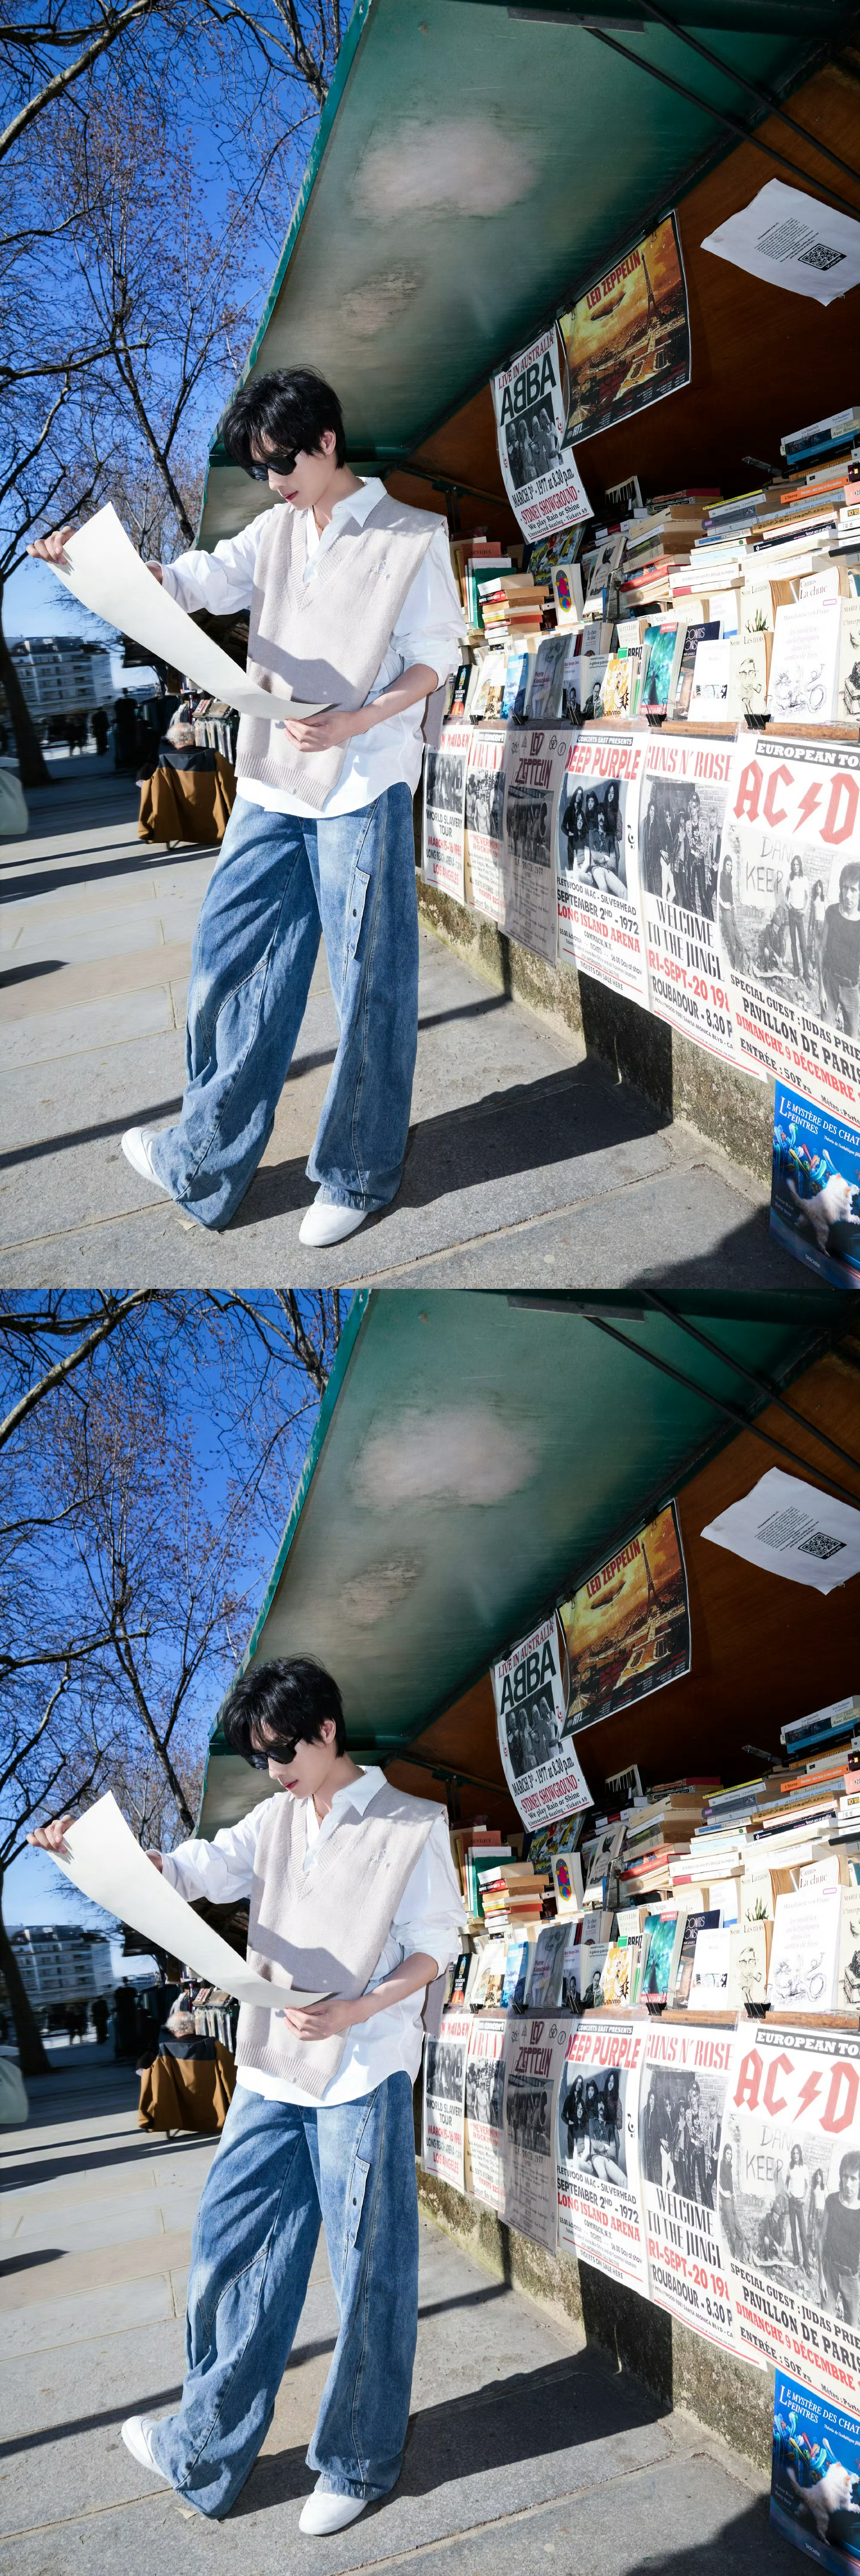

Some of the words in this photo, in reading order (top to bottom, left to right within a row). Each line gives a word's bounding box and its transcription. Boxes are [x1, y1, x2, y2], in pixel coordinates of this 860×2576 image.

[586, 288, 601, 310] LED
[601, 250, 641, 294] ZEPPELIN
[498, 368, 512, 390] LIVE
[513, 364, 520, 376] IN
[520, 333, 554, 371] AUSTRALIA
[500, 351, 556, 426] ABBA
[572, 423, 584, 437] RTL
[512, 488, 529, 508] MARCH
[536, 478, 548, 495] 1977
[548, 477, 553, 490] at
[552, 469, 563, 487] 8.30
[563, 468, 574, 486] p.m.
[521, 504, 541, 524] SYDNEY
[539, 486, 578, 516] SHOWGROUND
[538, 520, 546, 528] play
[546, 513, 559, 522] Rain
[565, 504, 580, 514] Shine
[528, 526, 549, 537] Unreserved
[550, 520, 564, 529] Seating
[566, 511, 581, 521] Tickets
[800, 580, 816, 588] Camus
[800, 589, 808, 599] La
[810, 584, 827, 597] chute
[592, 746, 642, 780] PURPLE
[756, 743, 836, 764] EUROPEAN
[426, 809, 442, 823] WORLD
[444, 815, 462, 829] SLAVERY
[439, 825, 452, 837] TOUR
[428, 836, 443, 849] MARCH
[433, 863, 442, 875] LOS
[442, 869, 459, 885] ANGELES
[534, 866, 543, 875] 1977
[557, 889, 598, 918] SEPTEMBER
[620, 915, 639, 935] 1972
[584, 888, 596, 900] MAC
[601, 894, 636, 916] SILVERHEAD
[558, 903, 579, 923] LONG
[580, 914, 608, 938] ISLAND
[611, 927, 641, 953] ARENA
[656, 899, 714, 948] WELCOME
[647, 921, 661, 946] TO
[662, 928, 683, 961] THE
[654, 997, 675, 1013] HOLLYWOOD
[683, 1015, 695, 1026] SANTA
[696, 1024, 711, 1037] MONICA
[712, 1034, 723, 1044] BLVD
[706, 1008, 725, 1035] 8.30
[731, 974, 765, 1003] SPECIAL
[766, 996, 795, 1021] GUEST
[802, 1016, 832, 1043] JUDAS
[742, 997, 799, 1046] PAVILLON
[801, 1034, 819, 1059] DE
[735, 1013, 784, 1056] DIMANCHE
[785, 1046, 791, 1060] 9
[792, 1050, 856, 1102] DÉCEMBRE
[740, 1037, 777, 1071] ENTRÉE
[787, 1111, 819, 1135] PEINTRES
[792, 1103, 822, 1126] MYSTÈRE
[823, 1120, 837, 1135] DES
[805, 1254, 820, 1268] TASCHEN
[586, 1577, 601, 1599] LED
[601, 1539, 641, 1583] ZEPPELIN
[498, 1657, 512, 1679] LIVE
[513, 1653, 520, 1665] IN
[520, 1622, 554, 1660] AUSTRALIA
[500, 1640, 556, 1715] ABBA
[572, 1712, 584, 1725] RTL
[512, 1777, 529, 1796] MARCH
[536, 1767, 548, 1784] 1977
[548, 1766, 553, 1778] at
[552, 1758, 563, 1776] 8.30
[563, 1757, 574, 1775] p.m.
[521, 1793, 541, 1813] SYDNEY
[539, 1774, 578, 1805] SHOWGROUND
[538, 1808, 546, 1817] play
[546, 1802, 559, 1811] Rain
[565, 1793, 580, 1803] Shine
[528, 1814, 549, 1826] Unreserved
[550, 1808, 564, 1817] Seating
[566, 1800, 581, 1810] Tickets
[800, 1869, 816, 1877] Camus
[800, 1878, 808, 1888] La
[810, 1873, 827, 1885] chute
[592, 2035, 642, 2069] PURPLE
[756, 2031, 836, 2053] EUROPEAN
[426, 2098, 442, 2112] WORLD
[444, 2104, 462, 2118] SLAVERY
[439, 2114, 452, 2126] TOUR
[428, 2125, 443, 2138] MARCH
[433, 2152, 442, 2164] LOS
[442, 2157, 459, 2174] ANGELES
[534, 2155, 543, 2164] 1977
[557, 2178, 598, 2206] SEPTEMBER
[620, 2204, 639, 2224] 1972
[584, 2177, 596, 2189] MAC
[601, 2183, 636, 2205] SILVERHEAD
[558, 2192, 579, 2212] LONG
[580, 2203, 608, 2227] ISLAND
[611, 2215, 641, 2242] ARENA
[656, 2187, 714, 2237] WELCOME
[647, 2209, 661, 2235] TO
[662, 2217, 683, 2249] THE
[654, 2286, 675, 2302] HOLLYWOOD
[683, 2304, 695, 2315] SANTA
[696, 2313, 711, 2325] MONICA
[712, 2323, 723, 2333] BLVD
[706, 2297, 725, 2324] 8.30
[731, 2263, 765, 2292] SPECIAL
[766, 2285, 795, 2310] GUEST
[802, 2305, 832, 2332] JUDAS
[742, 2286, 799, 2335] PAVILLON
[801, 2322, 819, 2348] DE
[735, 2301, 784, 2345] DIMANCHE
[785, 2334, 791, 2349] 9
[792, 2339, 856, 2391] DÉCEMBRE
[740, 2326, 777, 2360] ENTRÉE
[787, 2400, 819, 2423] PEINTRES
[792, 2392, 822, 2415] MYSTÈRE
[823, 2409, 837, 2423] DES
[805, 2543, 820, 2557] TASCHEN
